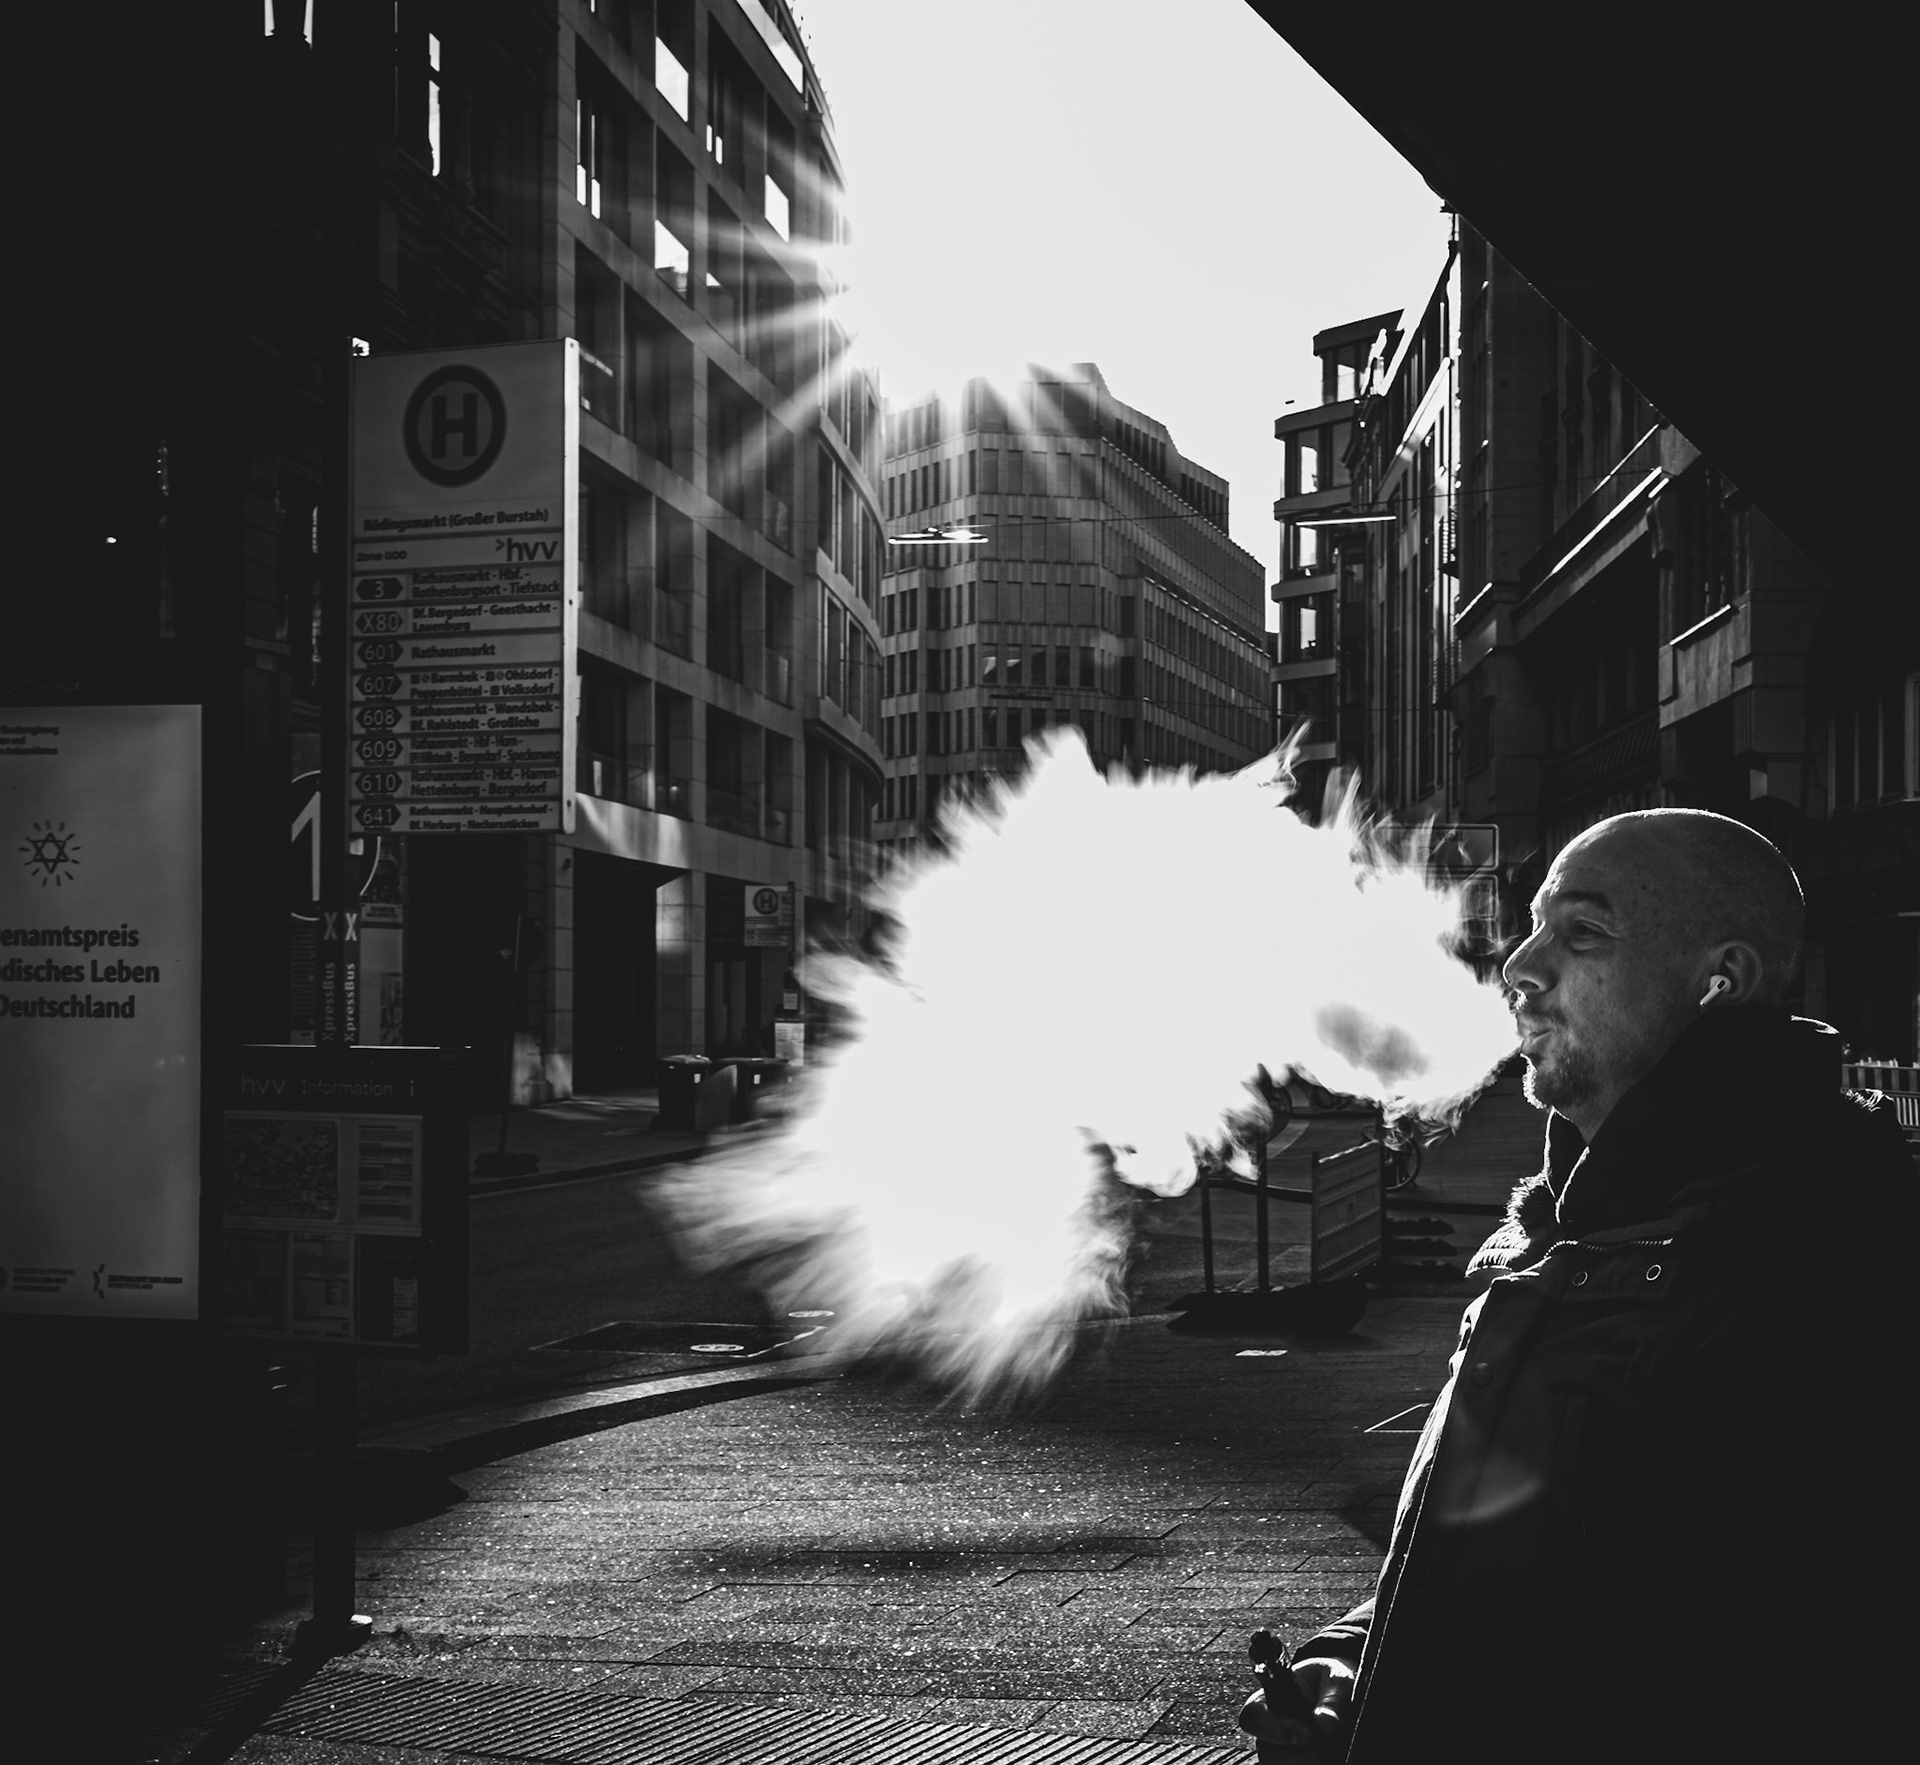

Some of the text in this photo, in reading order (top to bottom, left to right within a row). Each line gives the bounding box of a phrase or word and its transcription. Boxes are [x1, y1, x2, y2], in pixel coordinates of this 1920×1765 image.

[431, 392, 478, 460] H
[363, 508, 548, 533] Rödingsmarkt (Großer Burstah)
[356, 552, 383, 562] Zone
[412, 570, 490, 585] Rathausmarkt
[375, 581, 384, 598] 3
[509, 580, 560, 595] Tiefstack
[428, 605, 483, 621] Bergedorf
[490, 602, 551, 616] Geesthacht
[362, 613, 399, 632] X80
[365, 644, 395, 660] 601
[411, 643, 496, 659] Rathausmarkt
[363, 676, 395, 693] 607
[431, 671, 479, 684] Barmbek
[505, 668, 553, 681] Ohlsdorf
[502, 682, 554, 696] Volksdorf
[363, 709, 395, 726] 608
[411, 703, 487, 717] Rathausmarkt
[495, 701, 553, 714] Wandsbek
[427, 717, 480, 731] Rahlstedt
[362, 740, 396, 758] 609
[361, 773, 396, 792] 610
[488, 781, 547, 797] Bergedorf
[363, 808, 392, 824] 641
[760, 894, 773, 909] H
[324, 912, 338, 941] X
[345, 912, 358, 942] X
[0, 923, 140, 952] enamtspreis
[0, 957, 160, 983] disches Leben
[322, 963, 337, 1041] XpressBus
[344, 963, 357, 1042] XpressBus
[241, 1073, 286, 1095] hvv
[301, 1079, 393, 1096] Information
